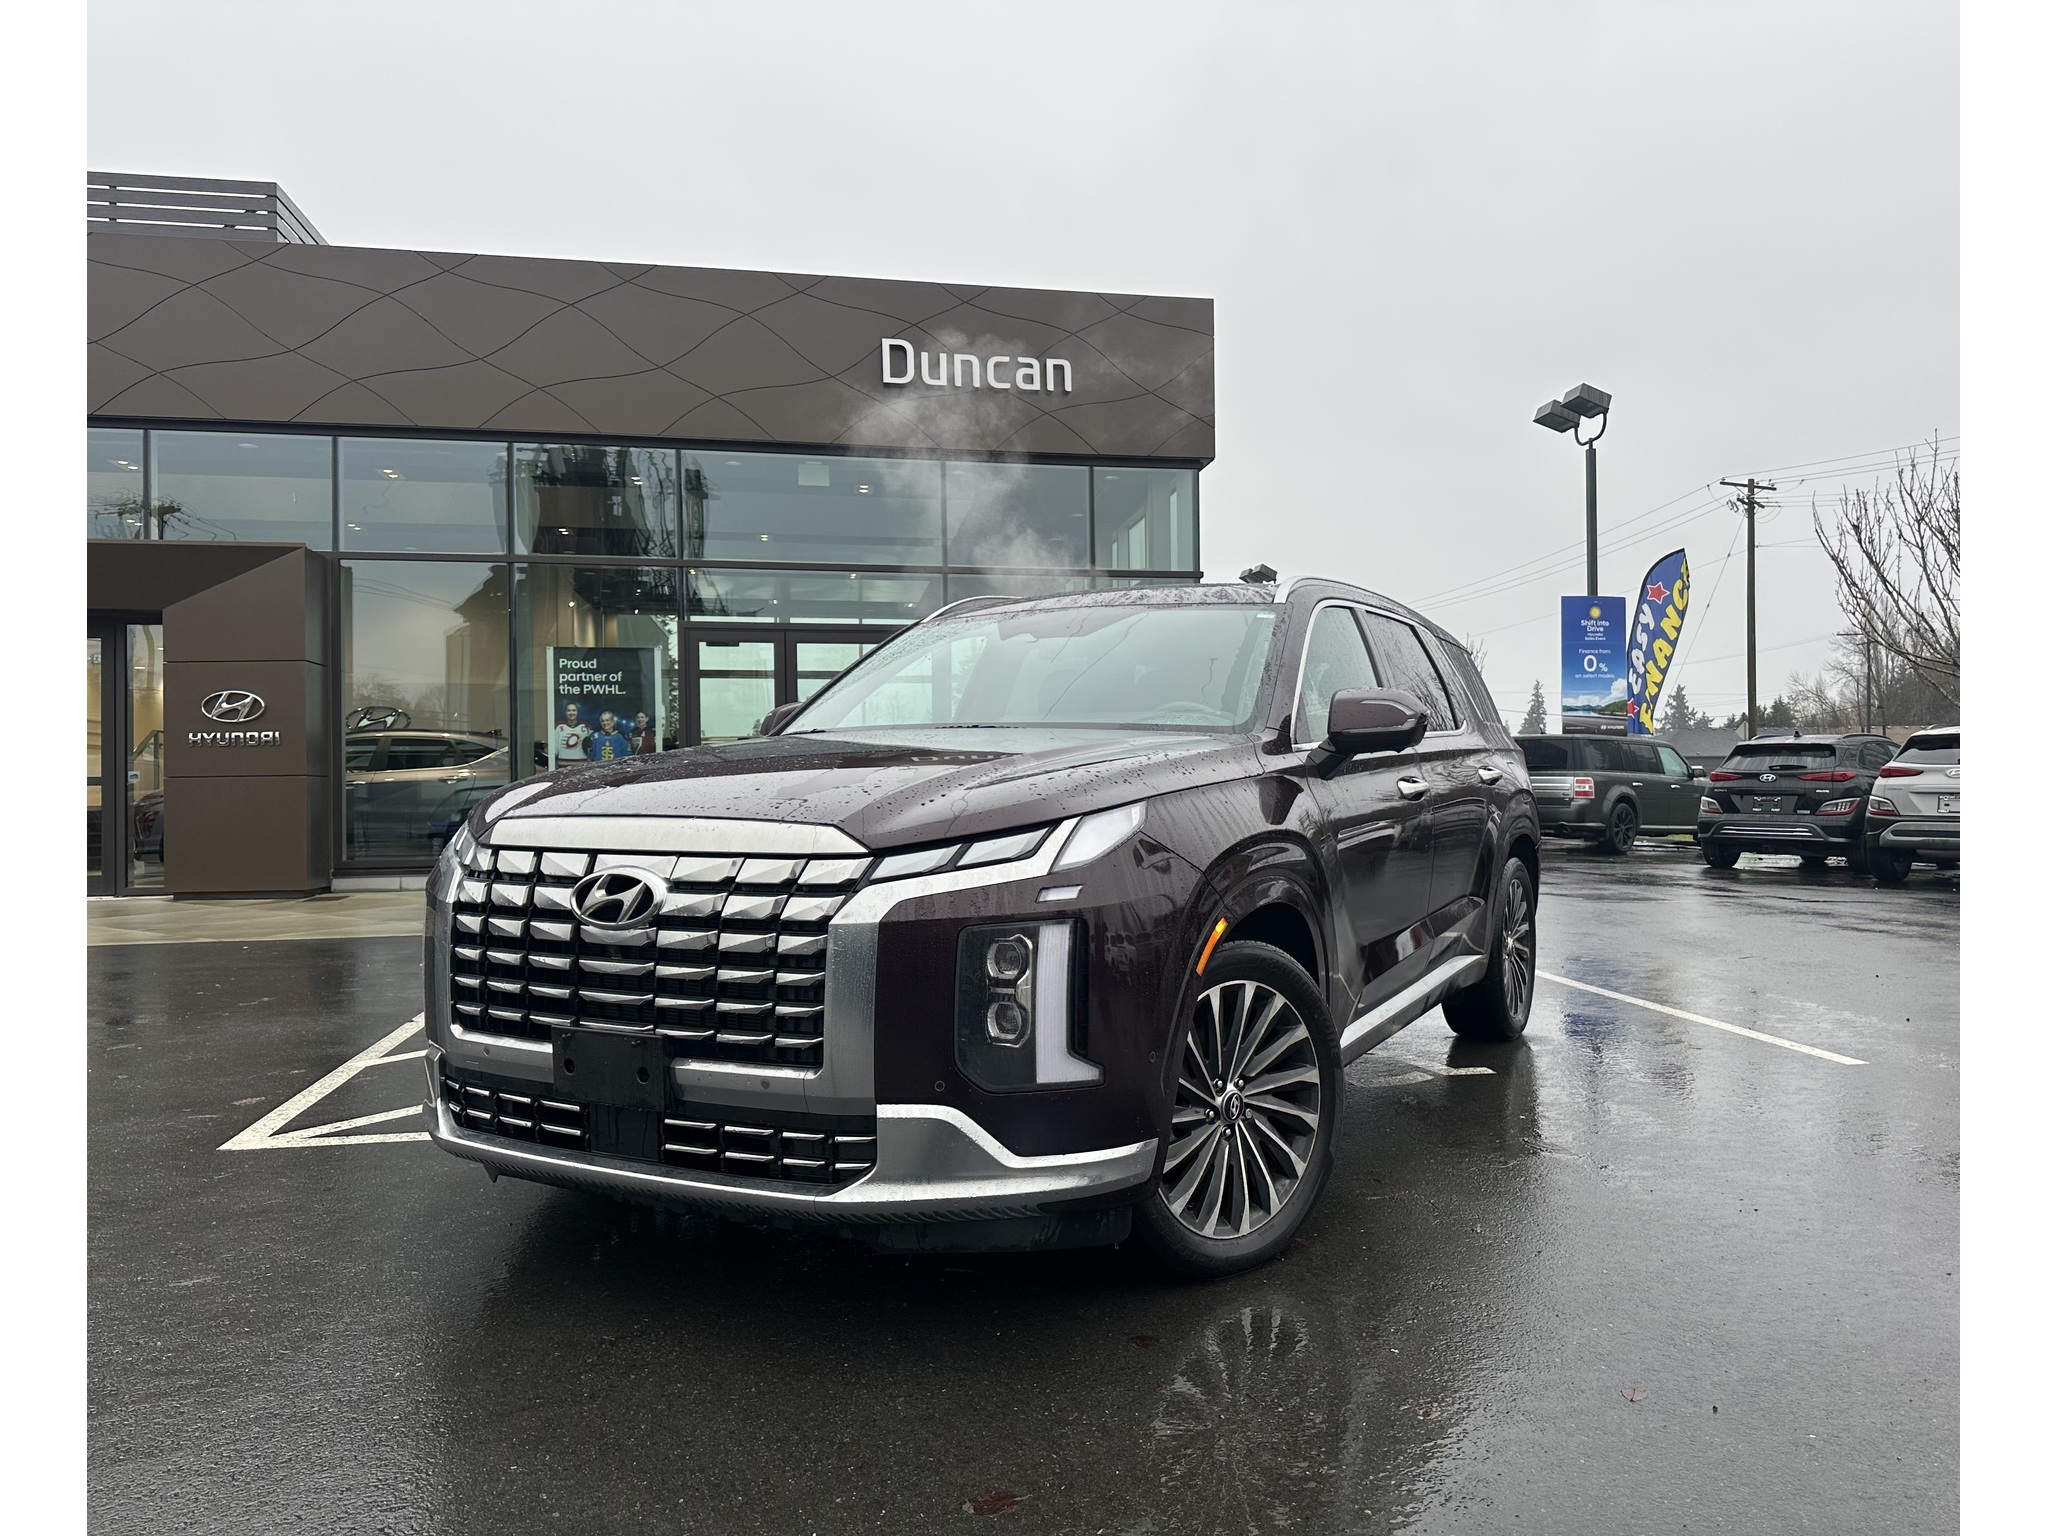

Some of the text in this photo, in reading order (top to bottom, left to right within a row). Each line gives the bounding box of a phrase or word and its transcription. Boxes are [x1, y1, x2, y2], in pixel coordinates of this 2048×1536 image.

[881, 337, 1072, 392] Duncan
[1628, 603, 1655, 694] EASY
[559, 658, 597, 669] Proud
[559, 671, 622, 683] partner of
[559, 684, 626, 695] the PWHL.
[188, 731, 280, 747] HYUNDAI
